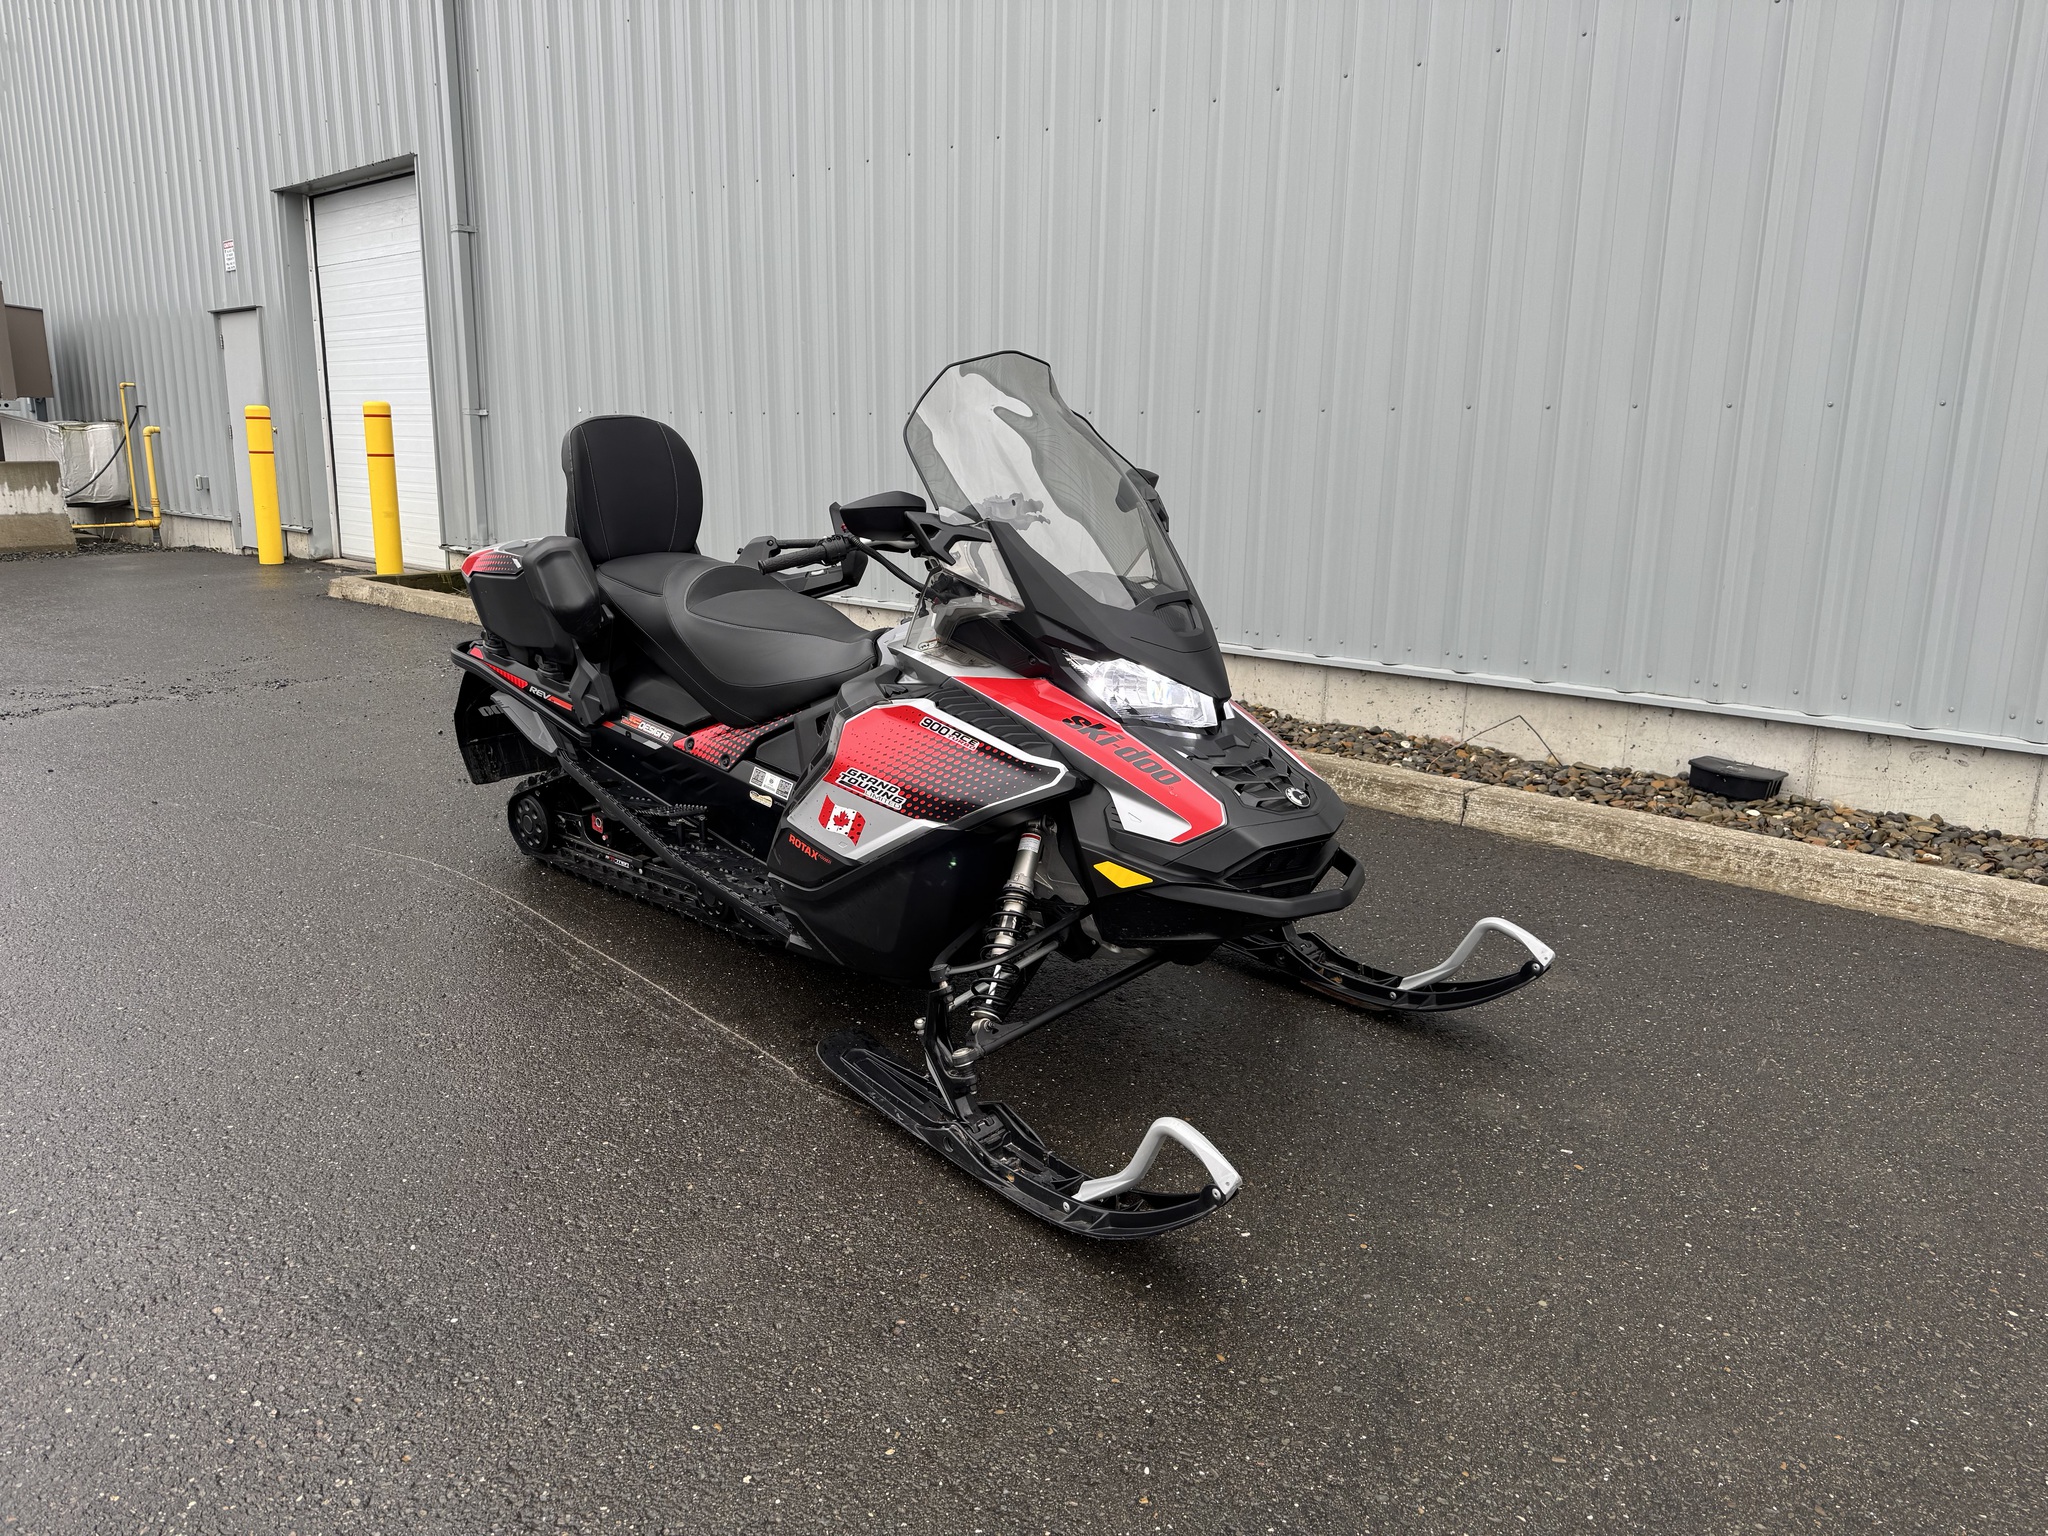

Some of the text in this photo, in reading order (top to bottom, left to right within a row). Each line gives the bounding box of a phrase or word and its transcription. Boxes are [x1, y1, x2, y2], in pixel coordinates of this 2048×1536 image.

[529, 686, 551, 699] REV
[638, 721, 672, 741] DESIGNS
[920, 718, 979, 746] 900 ACE
[948, 733, 976, 750] TURBO
[840, 773, 904, 804] TOURING
[846, 768, 899, 794] GRAND
[865, 790, 901, 809] LIMITED
[789, 833, 818, 860] ROTAX
